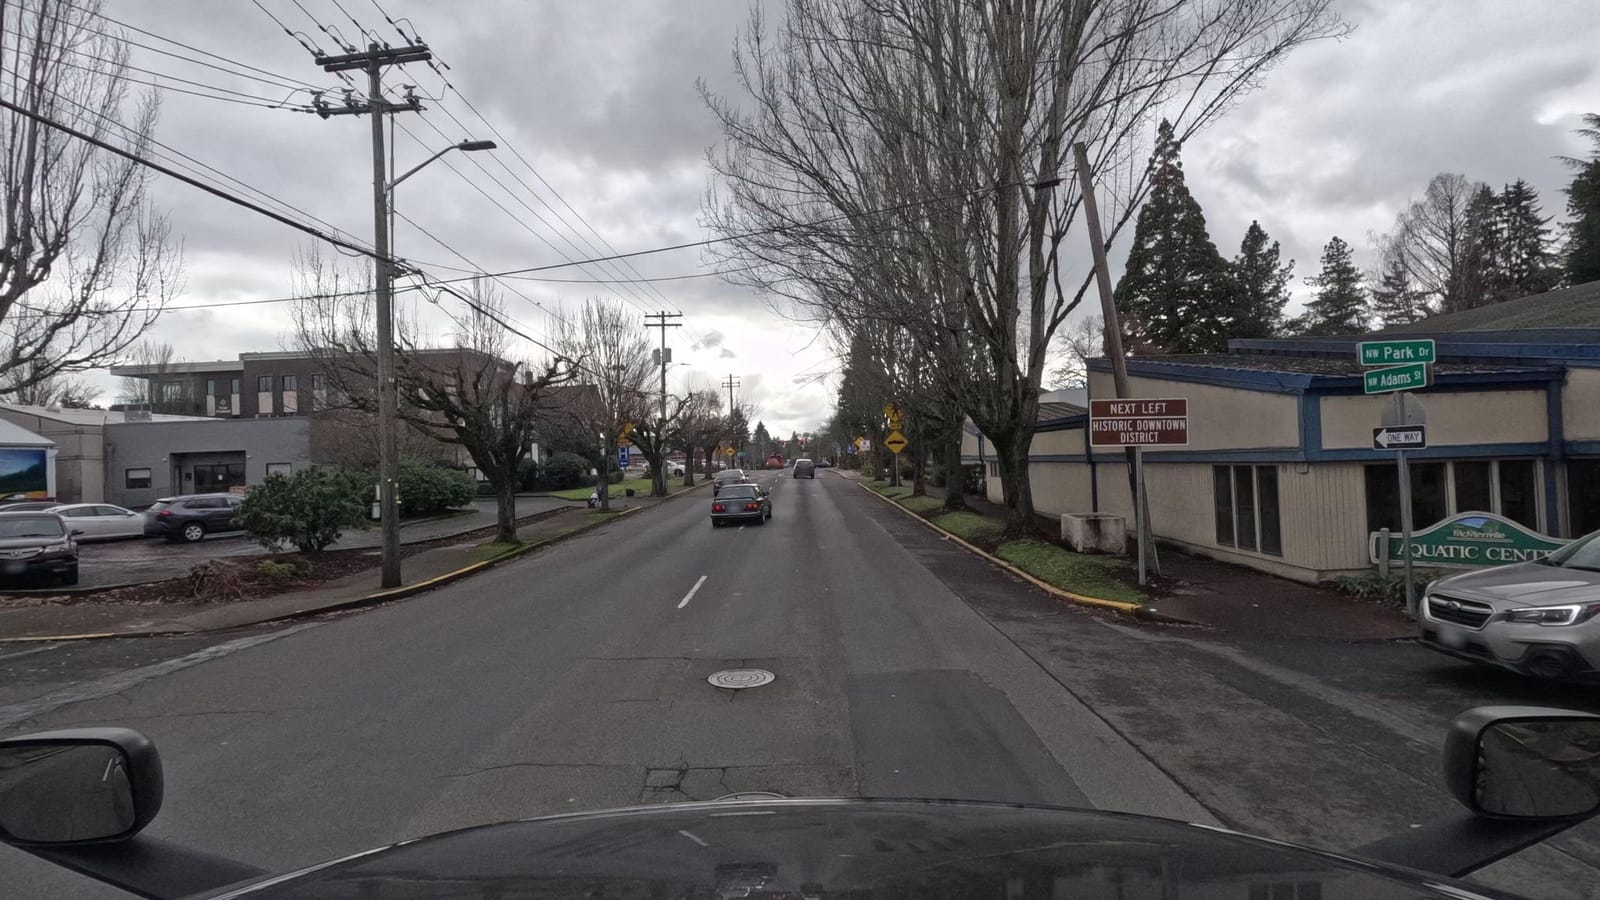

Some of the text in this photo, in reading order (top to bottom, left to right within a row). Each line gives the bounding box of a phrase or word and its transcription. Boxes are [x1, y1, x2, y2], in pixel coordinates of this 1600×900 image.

[1365, 346, 1430, 360] NW Park Dr
[1367, 370, 1422, 387] NW Adams St
[1110, 402, 1167, 415] NEXT LEFT
[1092, 419, 1186, 432] HISTORIC DOWNTOWN
[1120, 431, 1159, 443] DISTRICT
[1387, 431, 1419, 442] ONE WAY
